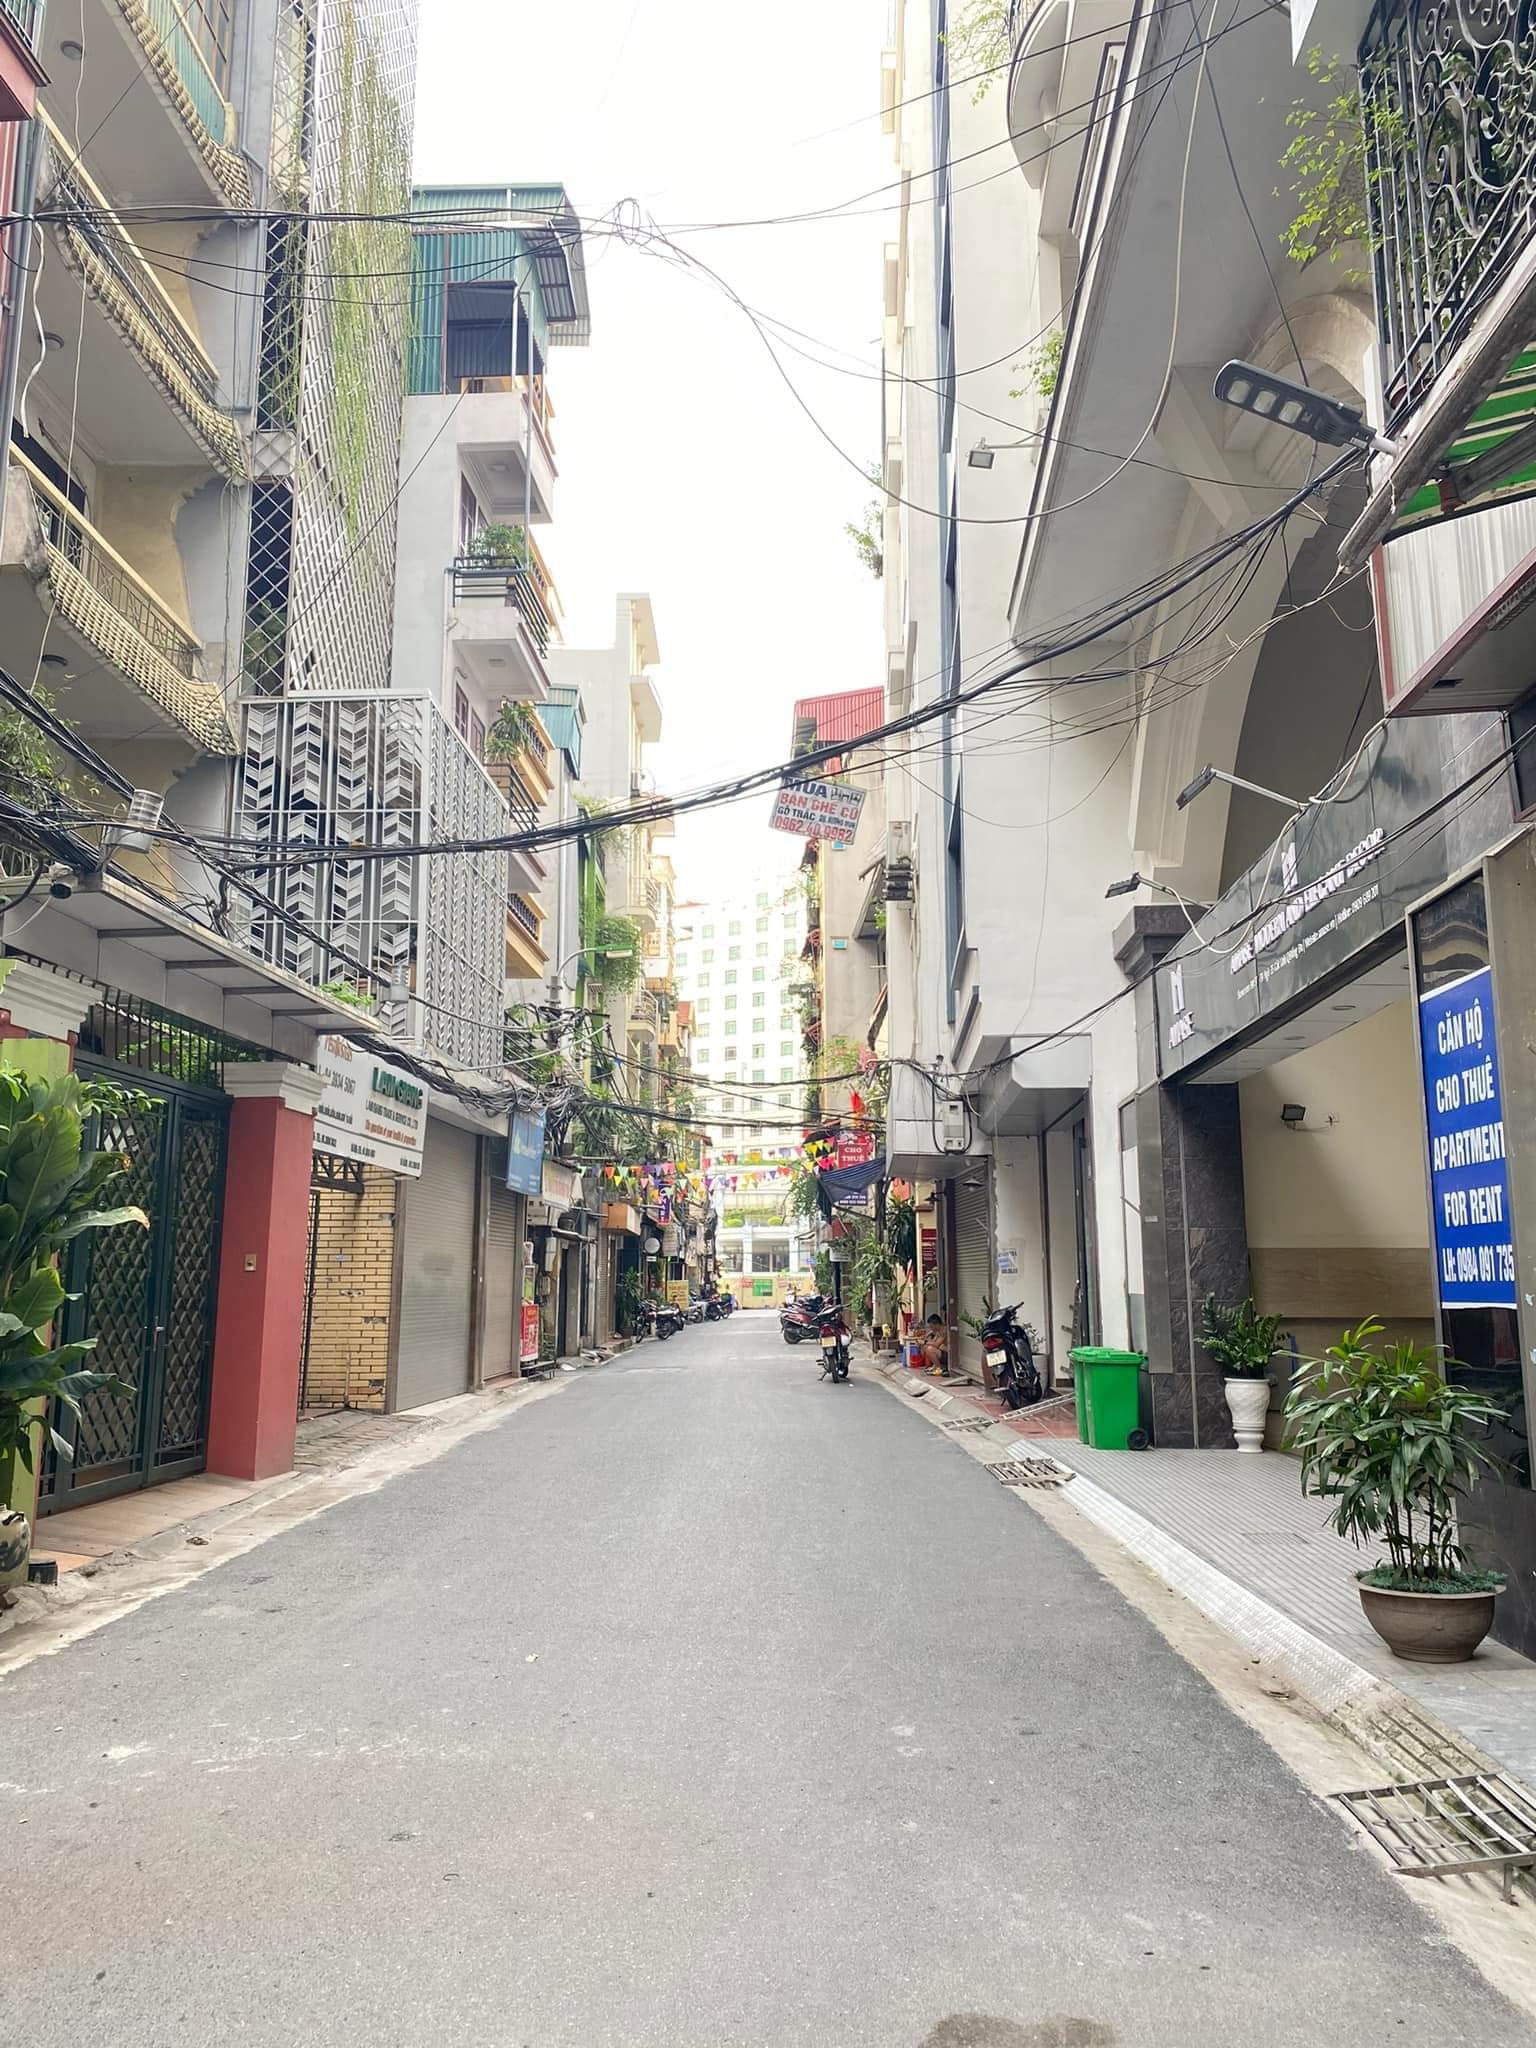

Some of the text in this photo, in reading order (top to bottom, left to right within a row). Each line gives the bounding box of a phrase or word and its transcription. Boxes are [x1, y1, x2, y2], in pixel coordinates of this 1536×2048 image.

[1438, 998, 1483, 1055] CĂN HỘ
[1436, 1054, 1495, 1113] CHO THUÊ
[1433, 1121, 1506, 1172] APARTMENT
[1443, 1184, 1503, 1228] FOR RENT
[1457, 1246, 1479, 1283] 0984
[1478, 1244, 1496, 1282] 091
[1496, 1243, 1516, 1282] 735
